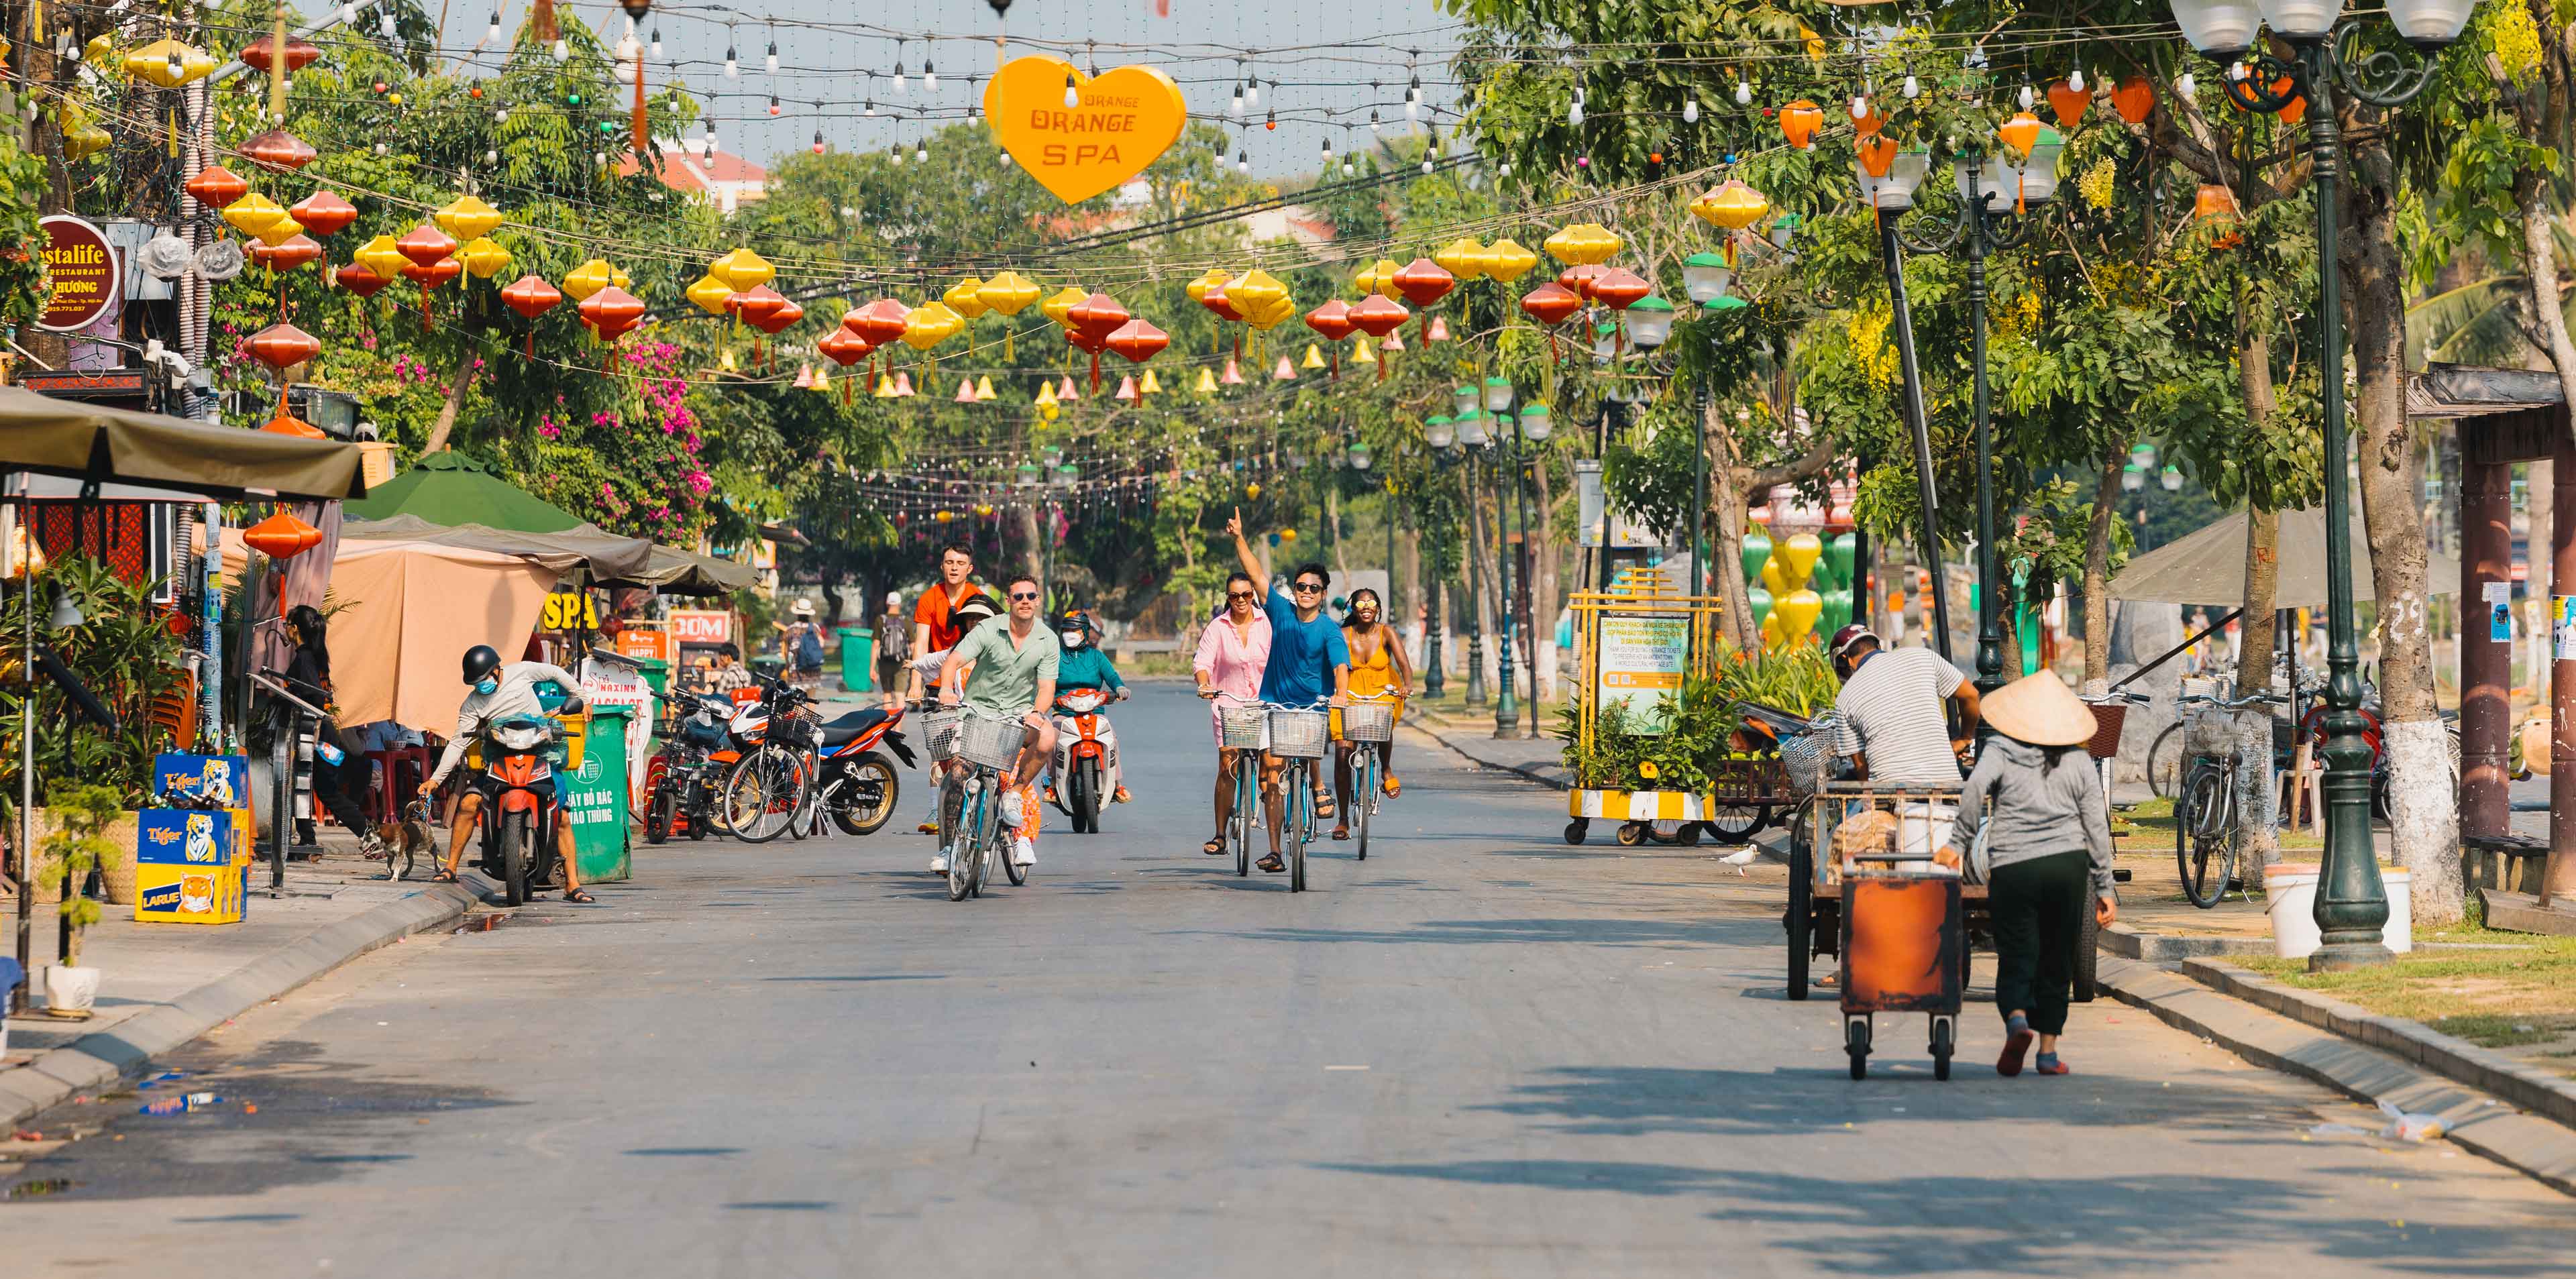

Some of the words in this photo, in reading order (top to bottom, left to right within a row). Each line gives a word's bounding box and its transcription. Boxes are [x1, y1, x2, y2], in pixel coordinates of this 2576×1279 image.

[1085, 95, 1140, 108] ORANGE
[1030, 109, 1136, 133] ORANGE
[1042, 144, 1121, 166] SPA
[56, 280, 98, 294] HƯƠNG
[543, 592, 599, 629] SPA
[584, 787, 594, 806] BỎ
[596, 789, 612, 805] RÁC
[568, 808, 584, 825] VÀO
[586, 806, 612, 824] THÙNG
[148, 827, 182, 845] Tiger
[143, 892, 180, 908] LARUE
